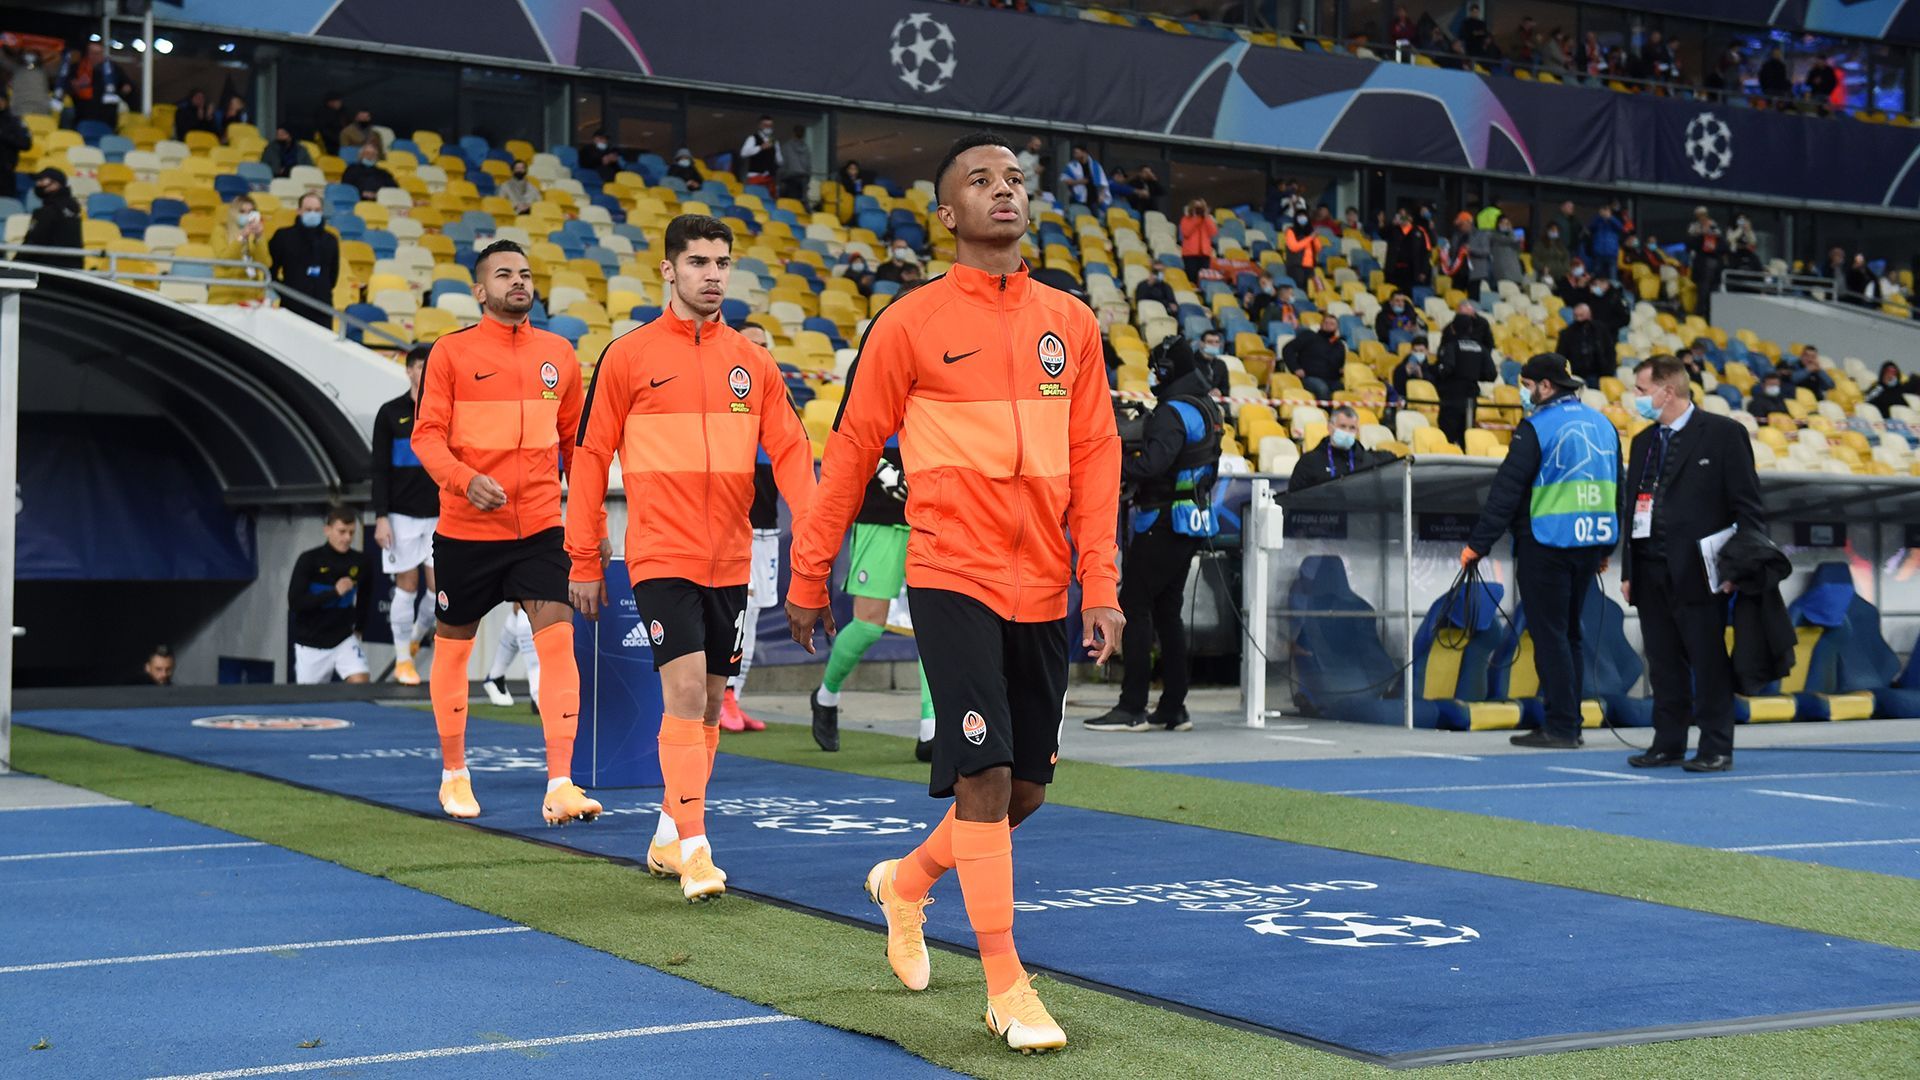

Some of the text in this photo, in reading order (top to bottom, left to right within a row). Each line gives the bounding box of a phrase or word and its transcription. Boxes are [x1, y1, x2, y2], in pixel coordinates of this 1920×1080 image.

[1577, 483, 1602, 507] HB
[1013, 880, 1378, 911] CHAMPIONS
[1056, 879, 1252, 896] LEAGUE
